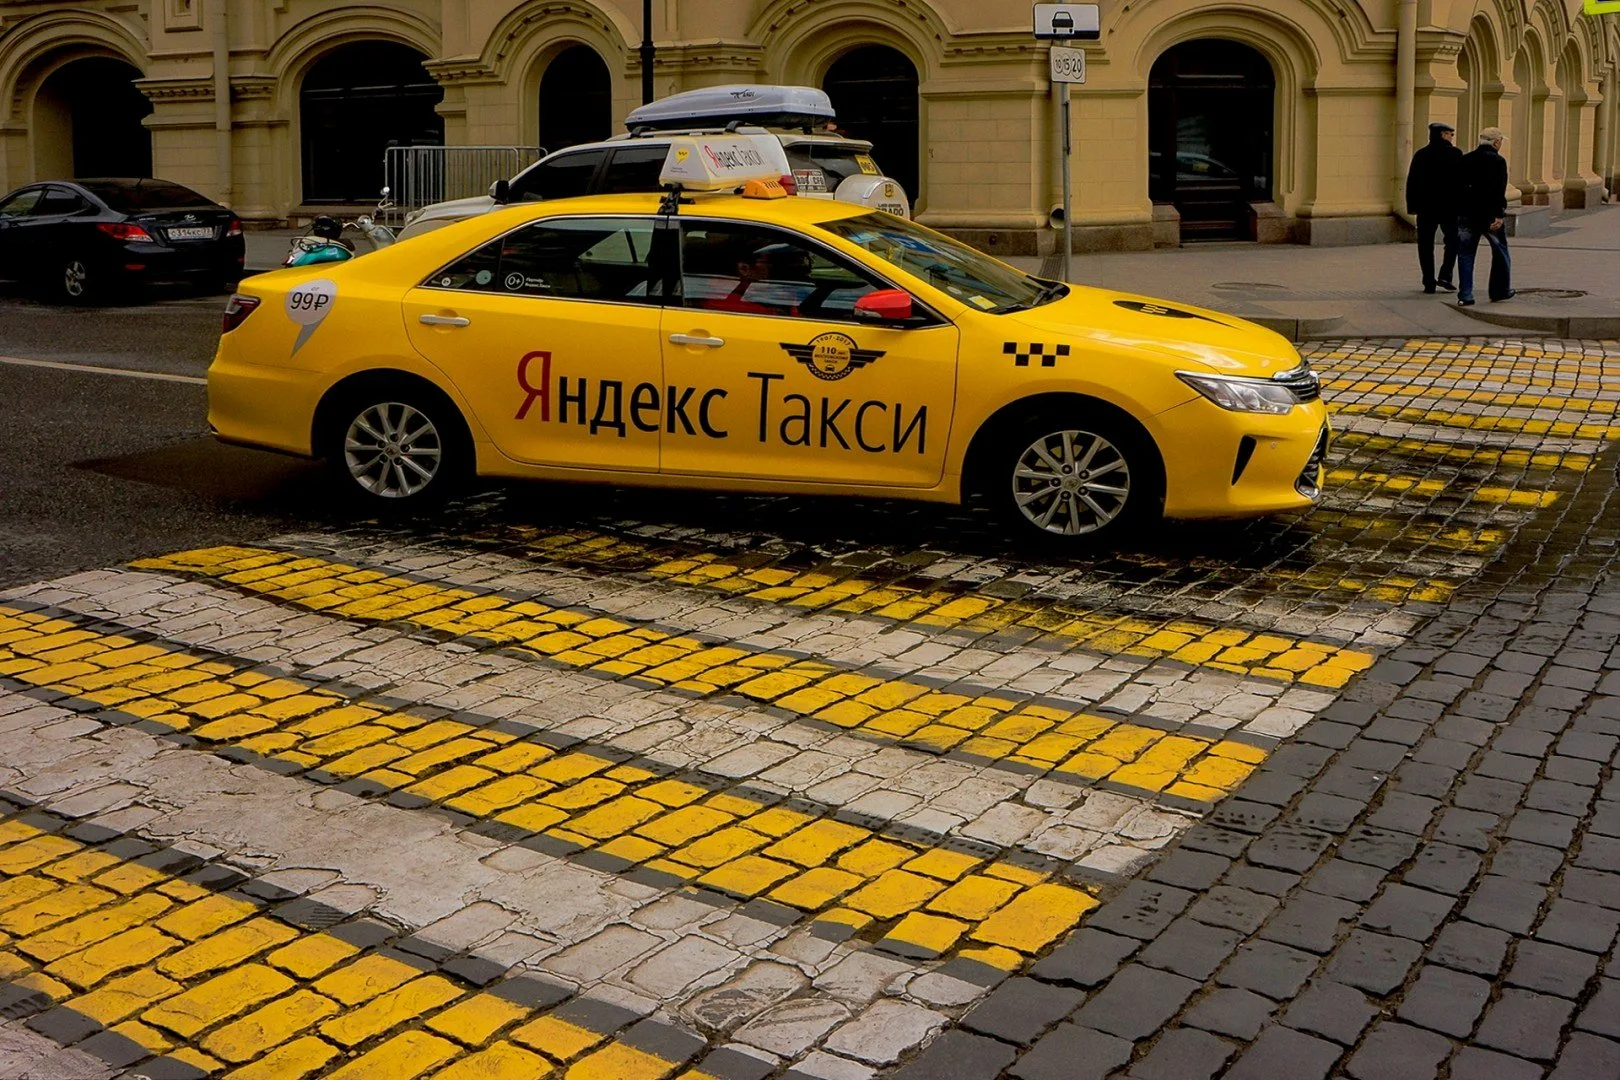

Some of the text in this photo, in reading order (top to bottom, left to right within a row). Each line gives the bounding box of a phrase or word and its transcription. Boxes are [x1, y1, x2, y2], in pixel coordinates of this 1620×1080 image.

[1063, 58, 1070, 71] 15
[1072, 57, 1082, 73] 20
[821, 346, 837, 355] 110
[514, 350, 927, 455] Яндекс Такси
